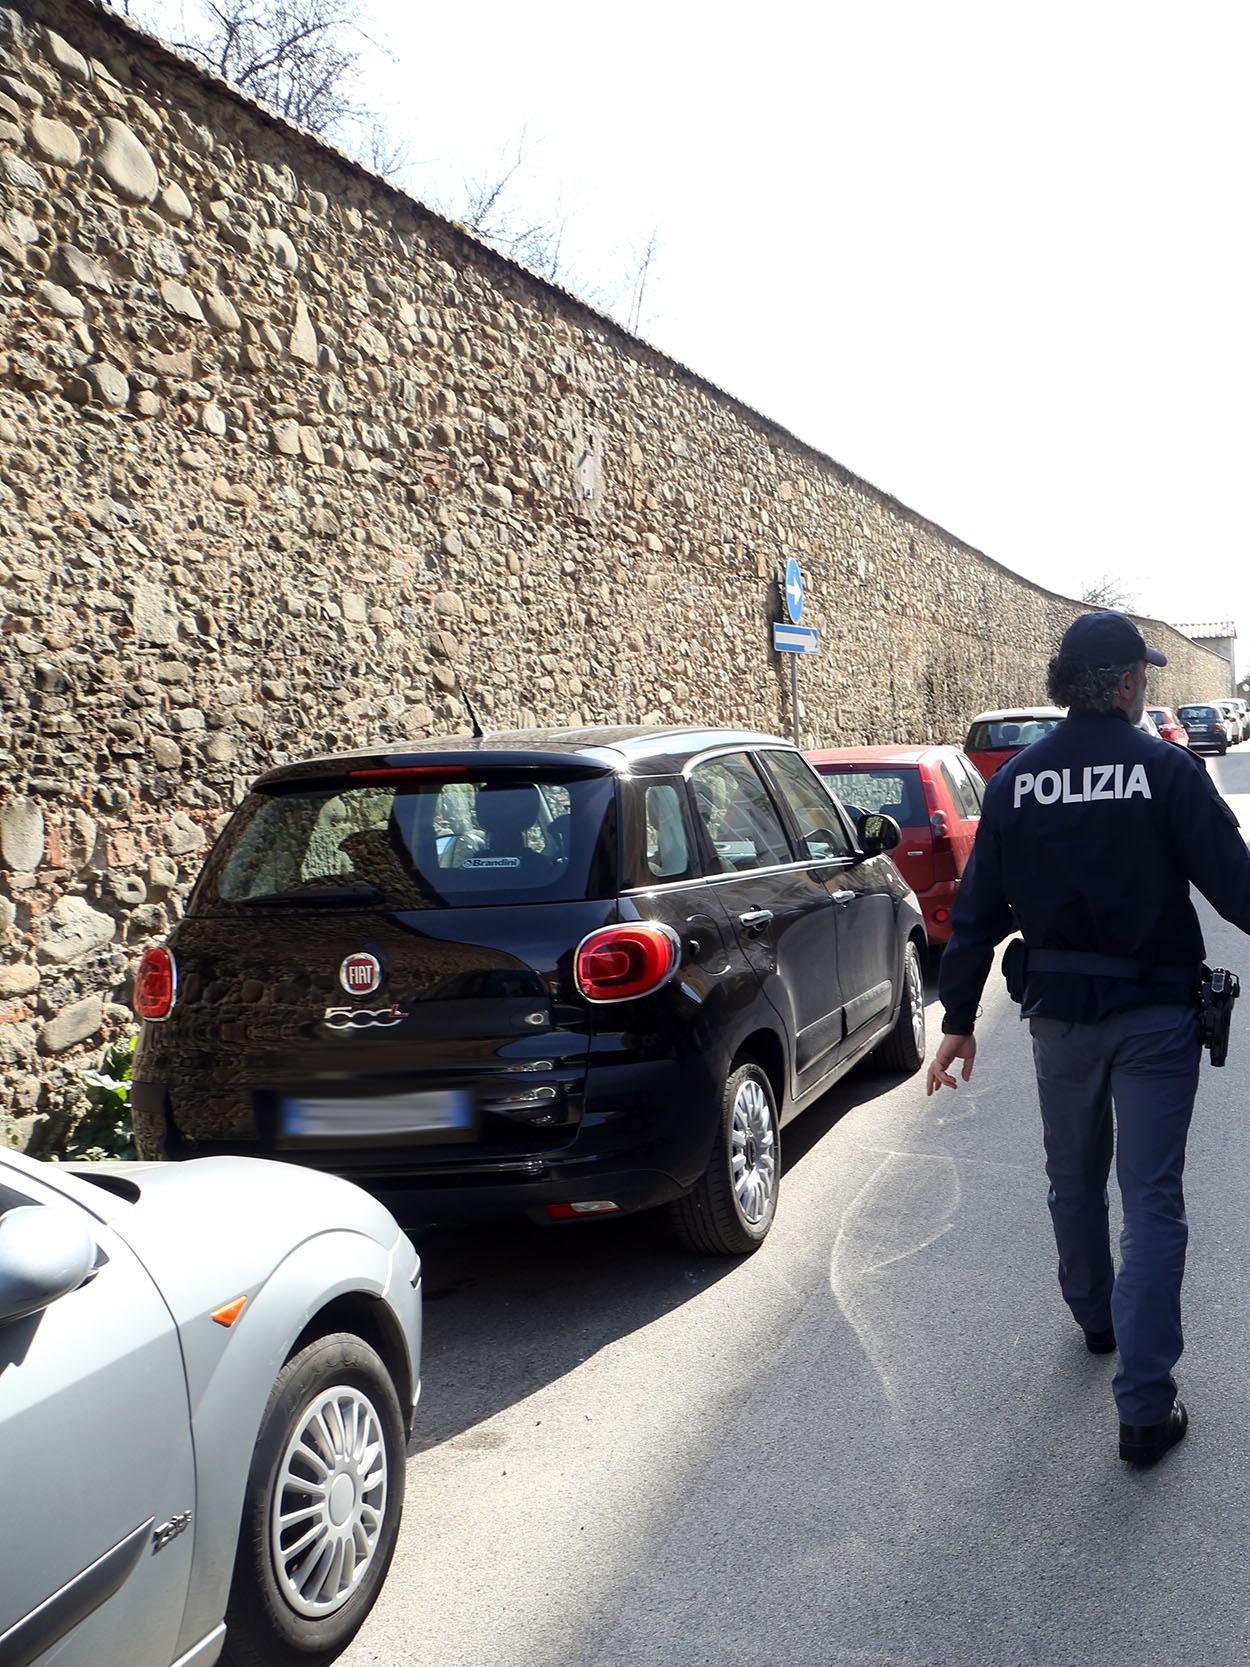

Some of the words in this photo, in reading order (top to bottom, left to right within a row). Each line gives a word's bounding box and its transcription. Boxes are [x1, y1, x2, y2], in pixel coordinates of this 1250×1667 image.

[1013, 764, 1152, 808] POLIZIA
[472, 858, 517, 867] Brandini
[348, 965, 373, 985] FIAT
